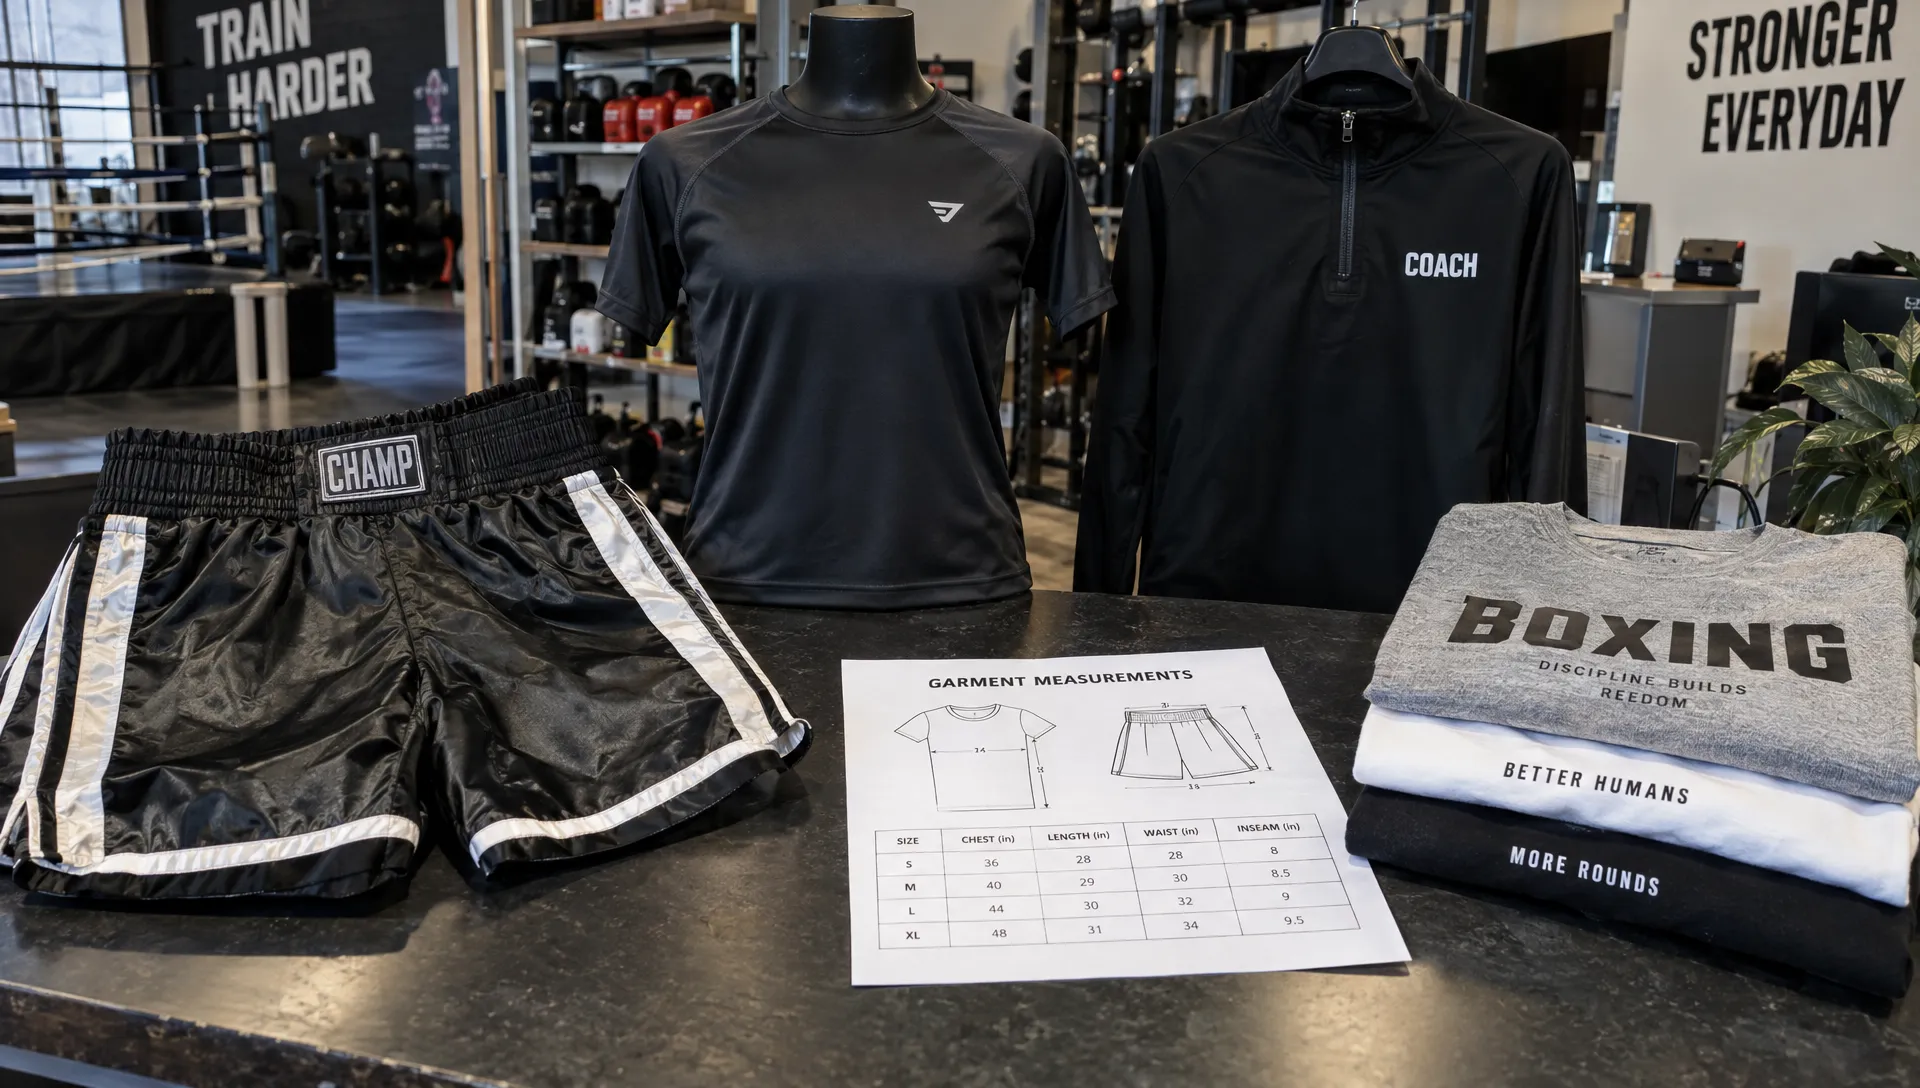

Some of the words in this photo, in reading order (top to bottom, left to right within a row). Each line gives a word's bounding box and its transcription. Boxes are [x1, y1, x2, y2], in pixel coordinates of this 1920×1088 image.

[195, 0, 311, 70] TRAIN
[1687, 0, 1899, 80] STRONGER
[227, 47, 375, 129] HARDER
[1701, 77, 1906, 153] EVERYDAY
[1404, 252, 1478, 278] COACH
[326, 444, 413, 493] CHAMP
[1447, 595, 1852, 684] BOXING
[928, 676, 1026, 689] GARMENT
[1034, 669, 1194, 686] MEASUREMENTS
[1538, 660, 1656, 686] DISCIPLINE
[1668, 677, 1747, 695] BUILDS
[1601, 687, 1688, 710] REEDOM
[1503, 761, 1583, 788] BETTER
[1594, 774, 1690, 805] HUMANS
[897, 836, 920, 845] SIZE
[961, 835, 995, 844] CHEST
[998, 834, 1015, 844] (in)
[1047, 831, 1091, 841] LENGTH
[1093, 830, 1110, 840] (in)
[1143, 828, 1178, 837] WAIST
[1181, 827, 1199, 836] (in)
[1237, 823, 1280, 832] INSEAM
[1283, 822, 1300, 832] (in)
[905, 860, 912, 869] S
[984, 858, 999, 867] 36
[1075, 854, 1091, 864] 28
[1168, 850, 1183, 860] 28
[1270, 846, 1279, 855] 8
[1509, 846, 1567, 875] MORE
[1578, 860, 1660, 897] ROUNDS
[904, 883, 916, 892] M
[986, 881, 1002, 890] 40
[1079, 877, 1095, 887] 29
[1172, 873, 1188, 883] 30
[1271, 869, 1291, 878] 8.5
[908, 906, 915, 915] L
[988, 904, 1004, 913] 44
[1083, 901, 1099, 910] 30
[1177, 896, 1193, 906] 32
[1281, 891, 1290, 901] 9
[905, 931, 920, 940] XL
[991, 929, 1007, 938] 48
[1087, 925, 1102, 934] 31
[1183, 920, 1199, 931] 34
[1284, 915, 1304, 925] 9.5
